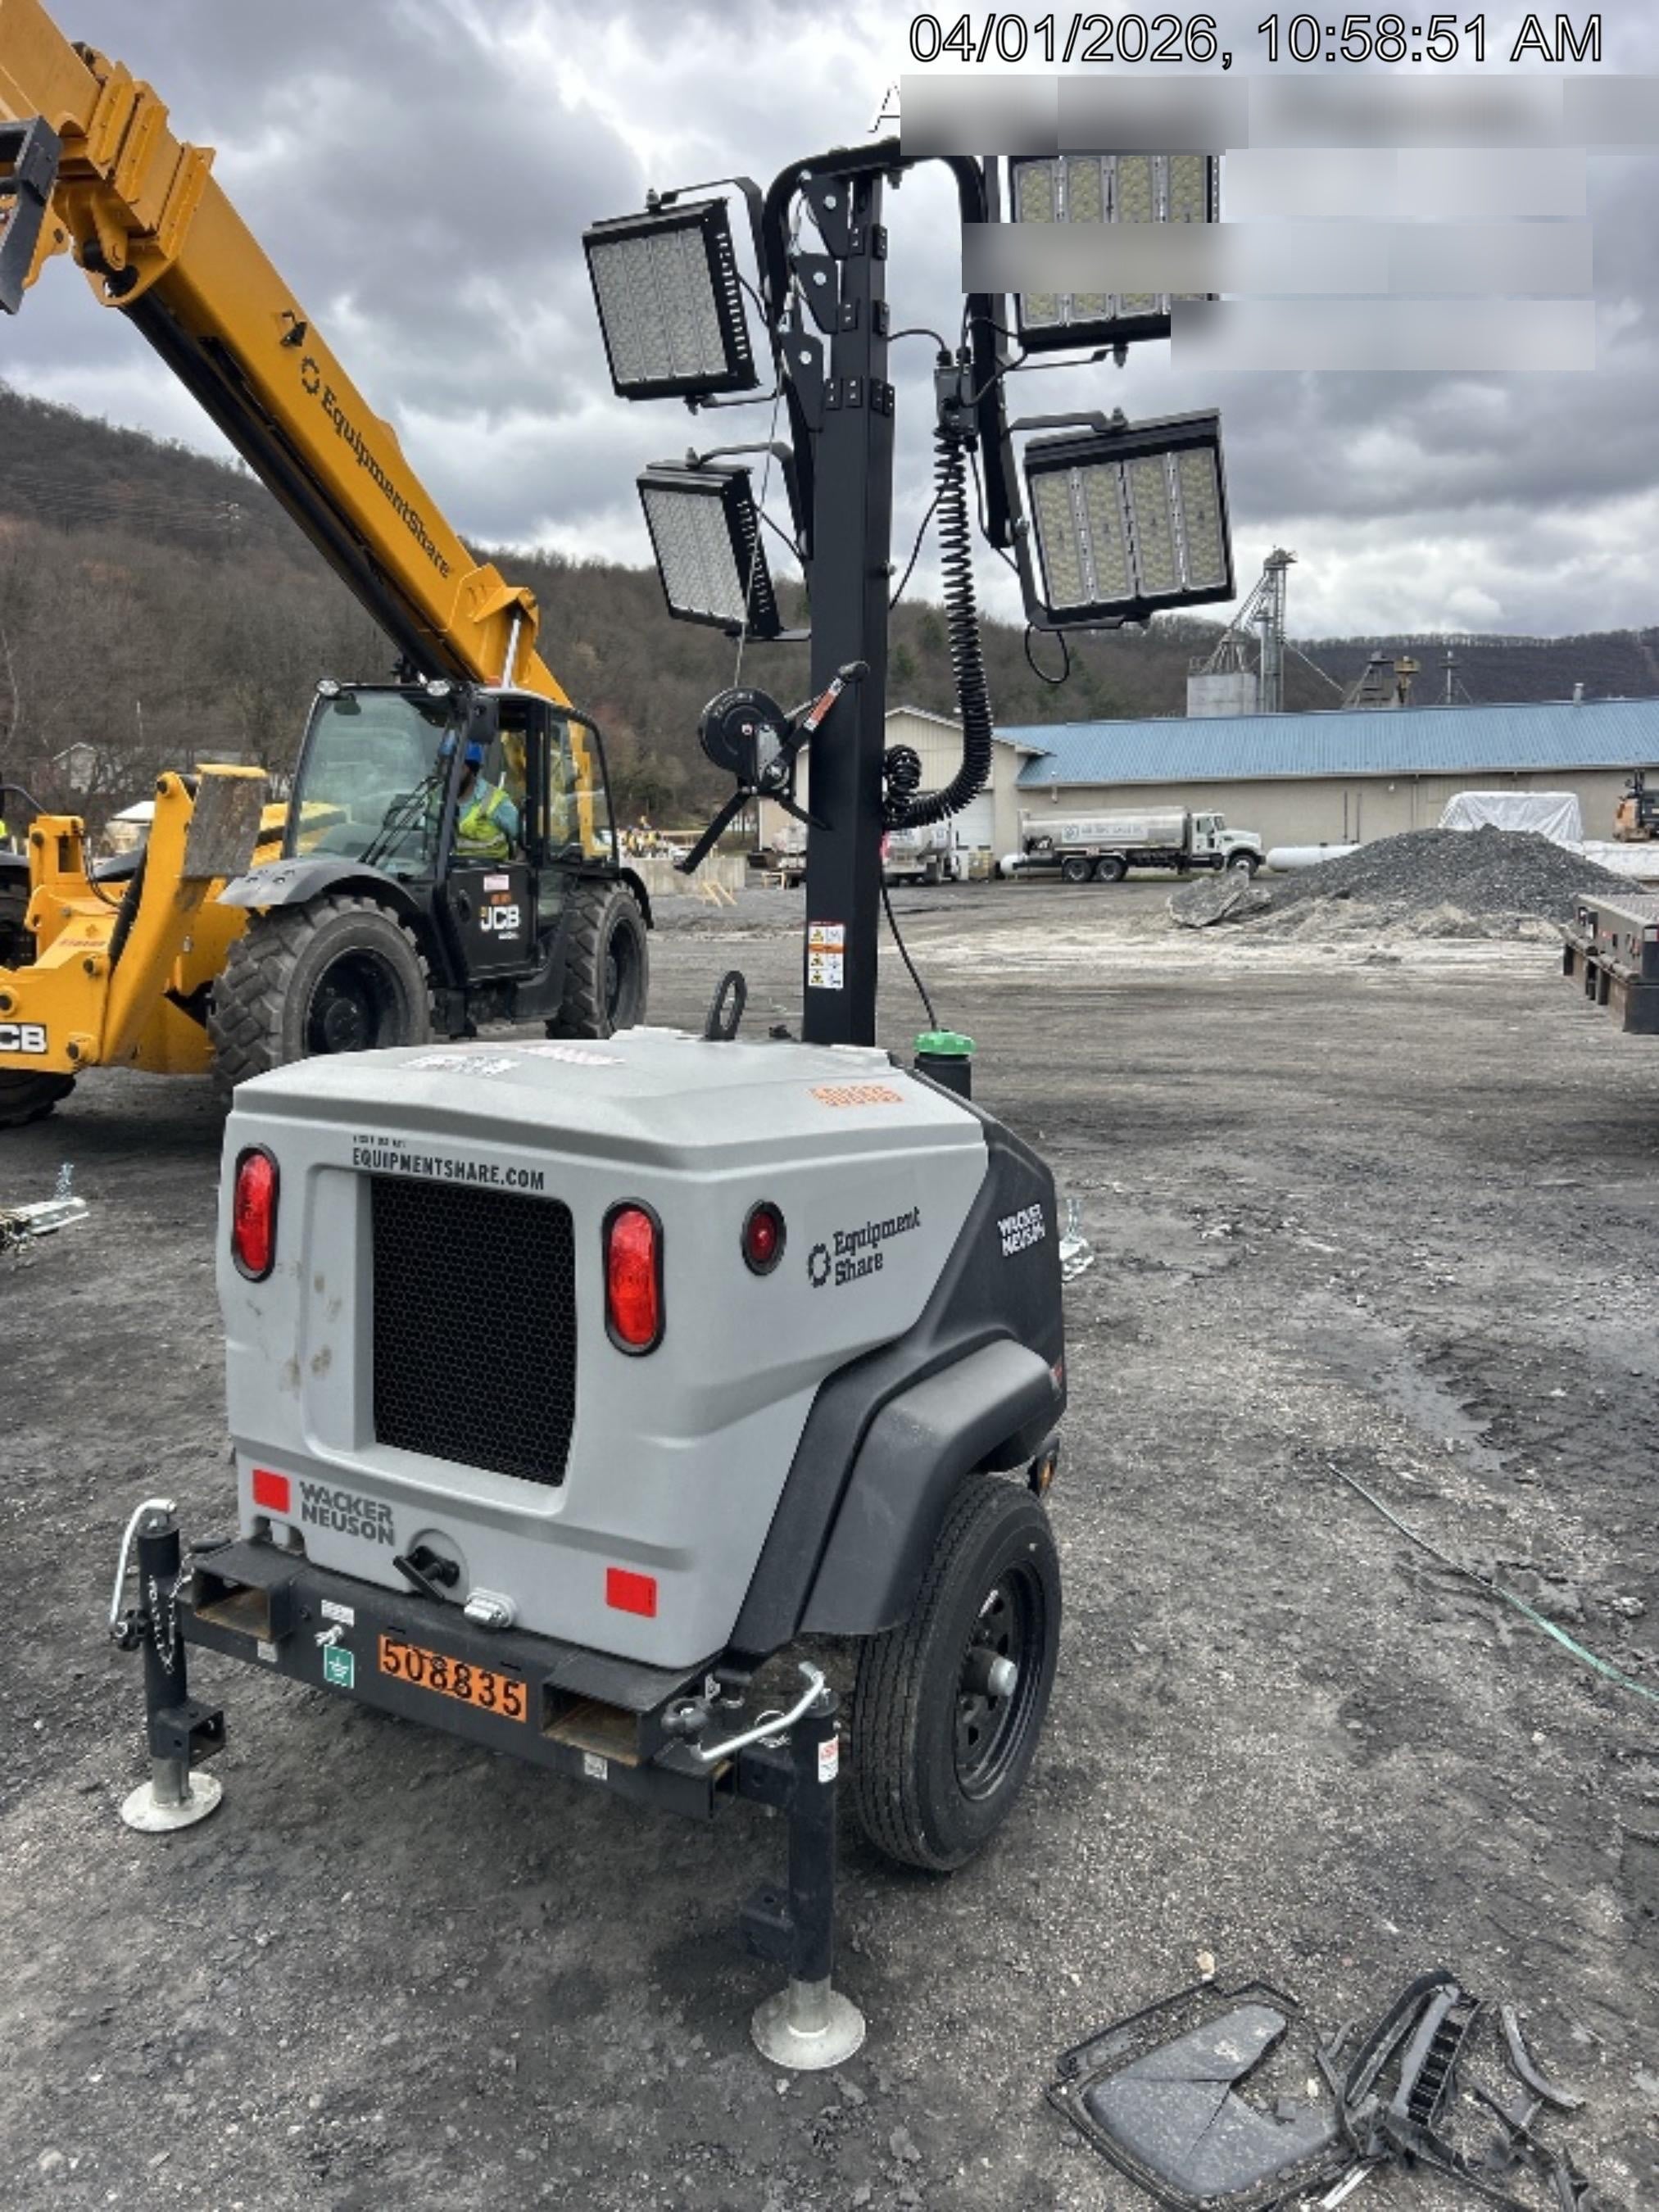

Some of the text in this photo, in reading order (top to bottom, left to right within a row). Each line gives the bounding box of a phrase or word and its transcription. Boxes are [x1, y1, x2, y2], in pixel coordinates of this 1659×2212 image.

[321, 386, 451, 578] EquipmentShare
[480, 905, 519, 931] JCB
[353, 1147, 544, 1190] EQUIPMENTSHARE.COM
[832, 1206, 920, 1256] Equipment
[835, 1252, 883, 1286] Share
[299, 1480, 394, 1526] WACKER
[301, 1500, 396, 1548] NEUSON
[383, 1639, 522, 1717] 508835
